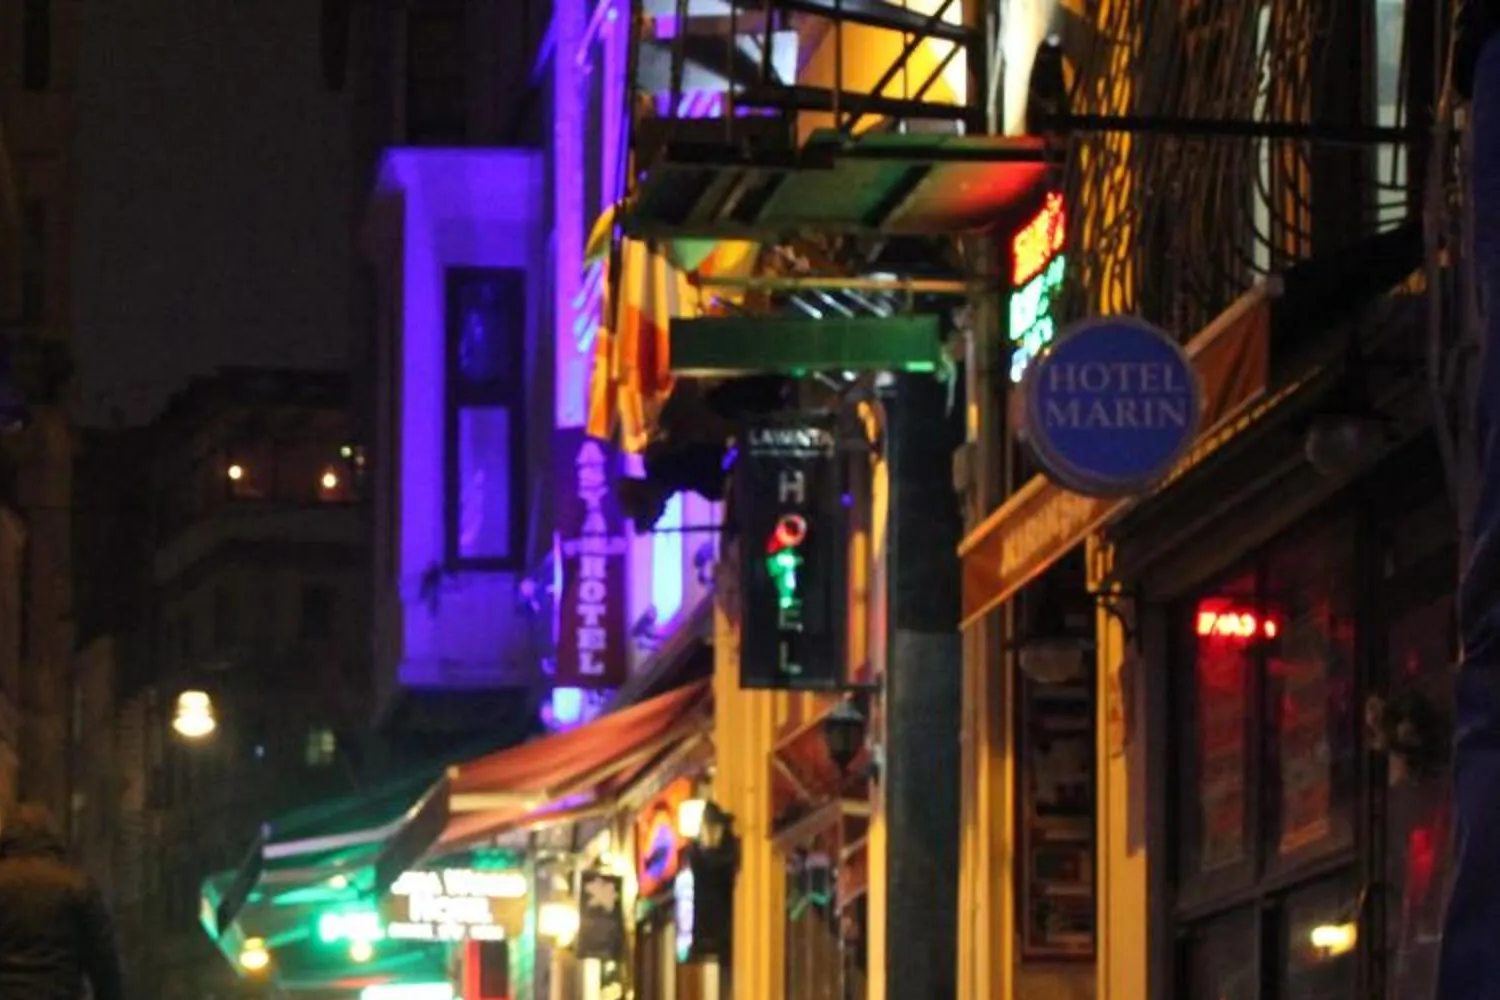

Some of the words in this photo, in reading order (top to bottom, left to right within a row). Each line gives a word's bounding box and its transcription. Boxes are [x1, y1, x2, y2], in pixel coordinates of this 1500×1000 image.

[1047, 399, 1188, 429] MARIN
[1049, 362, 1186, 393] HOTEL
[778, 470, 808, 674] HOTEL
[576, 554, 607, 676] HOTEL
